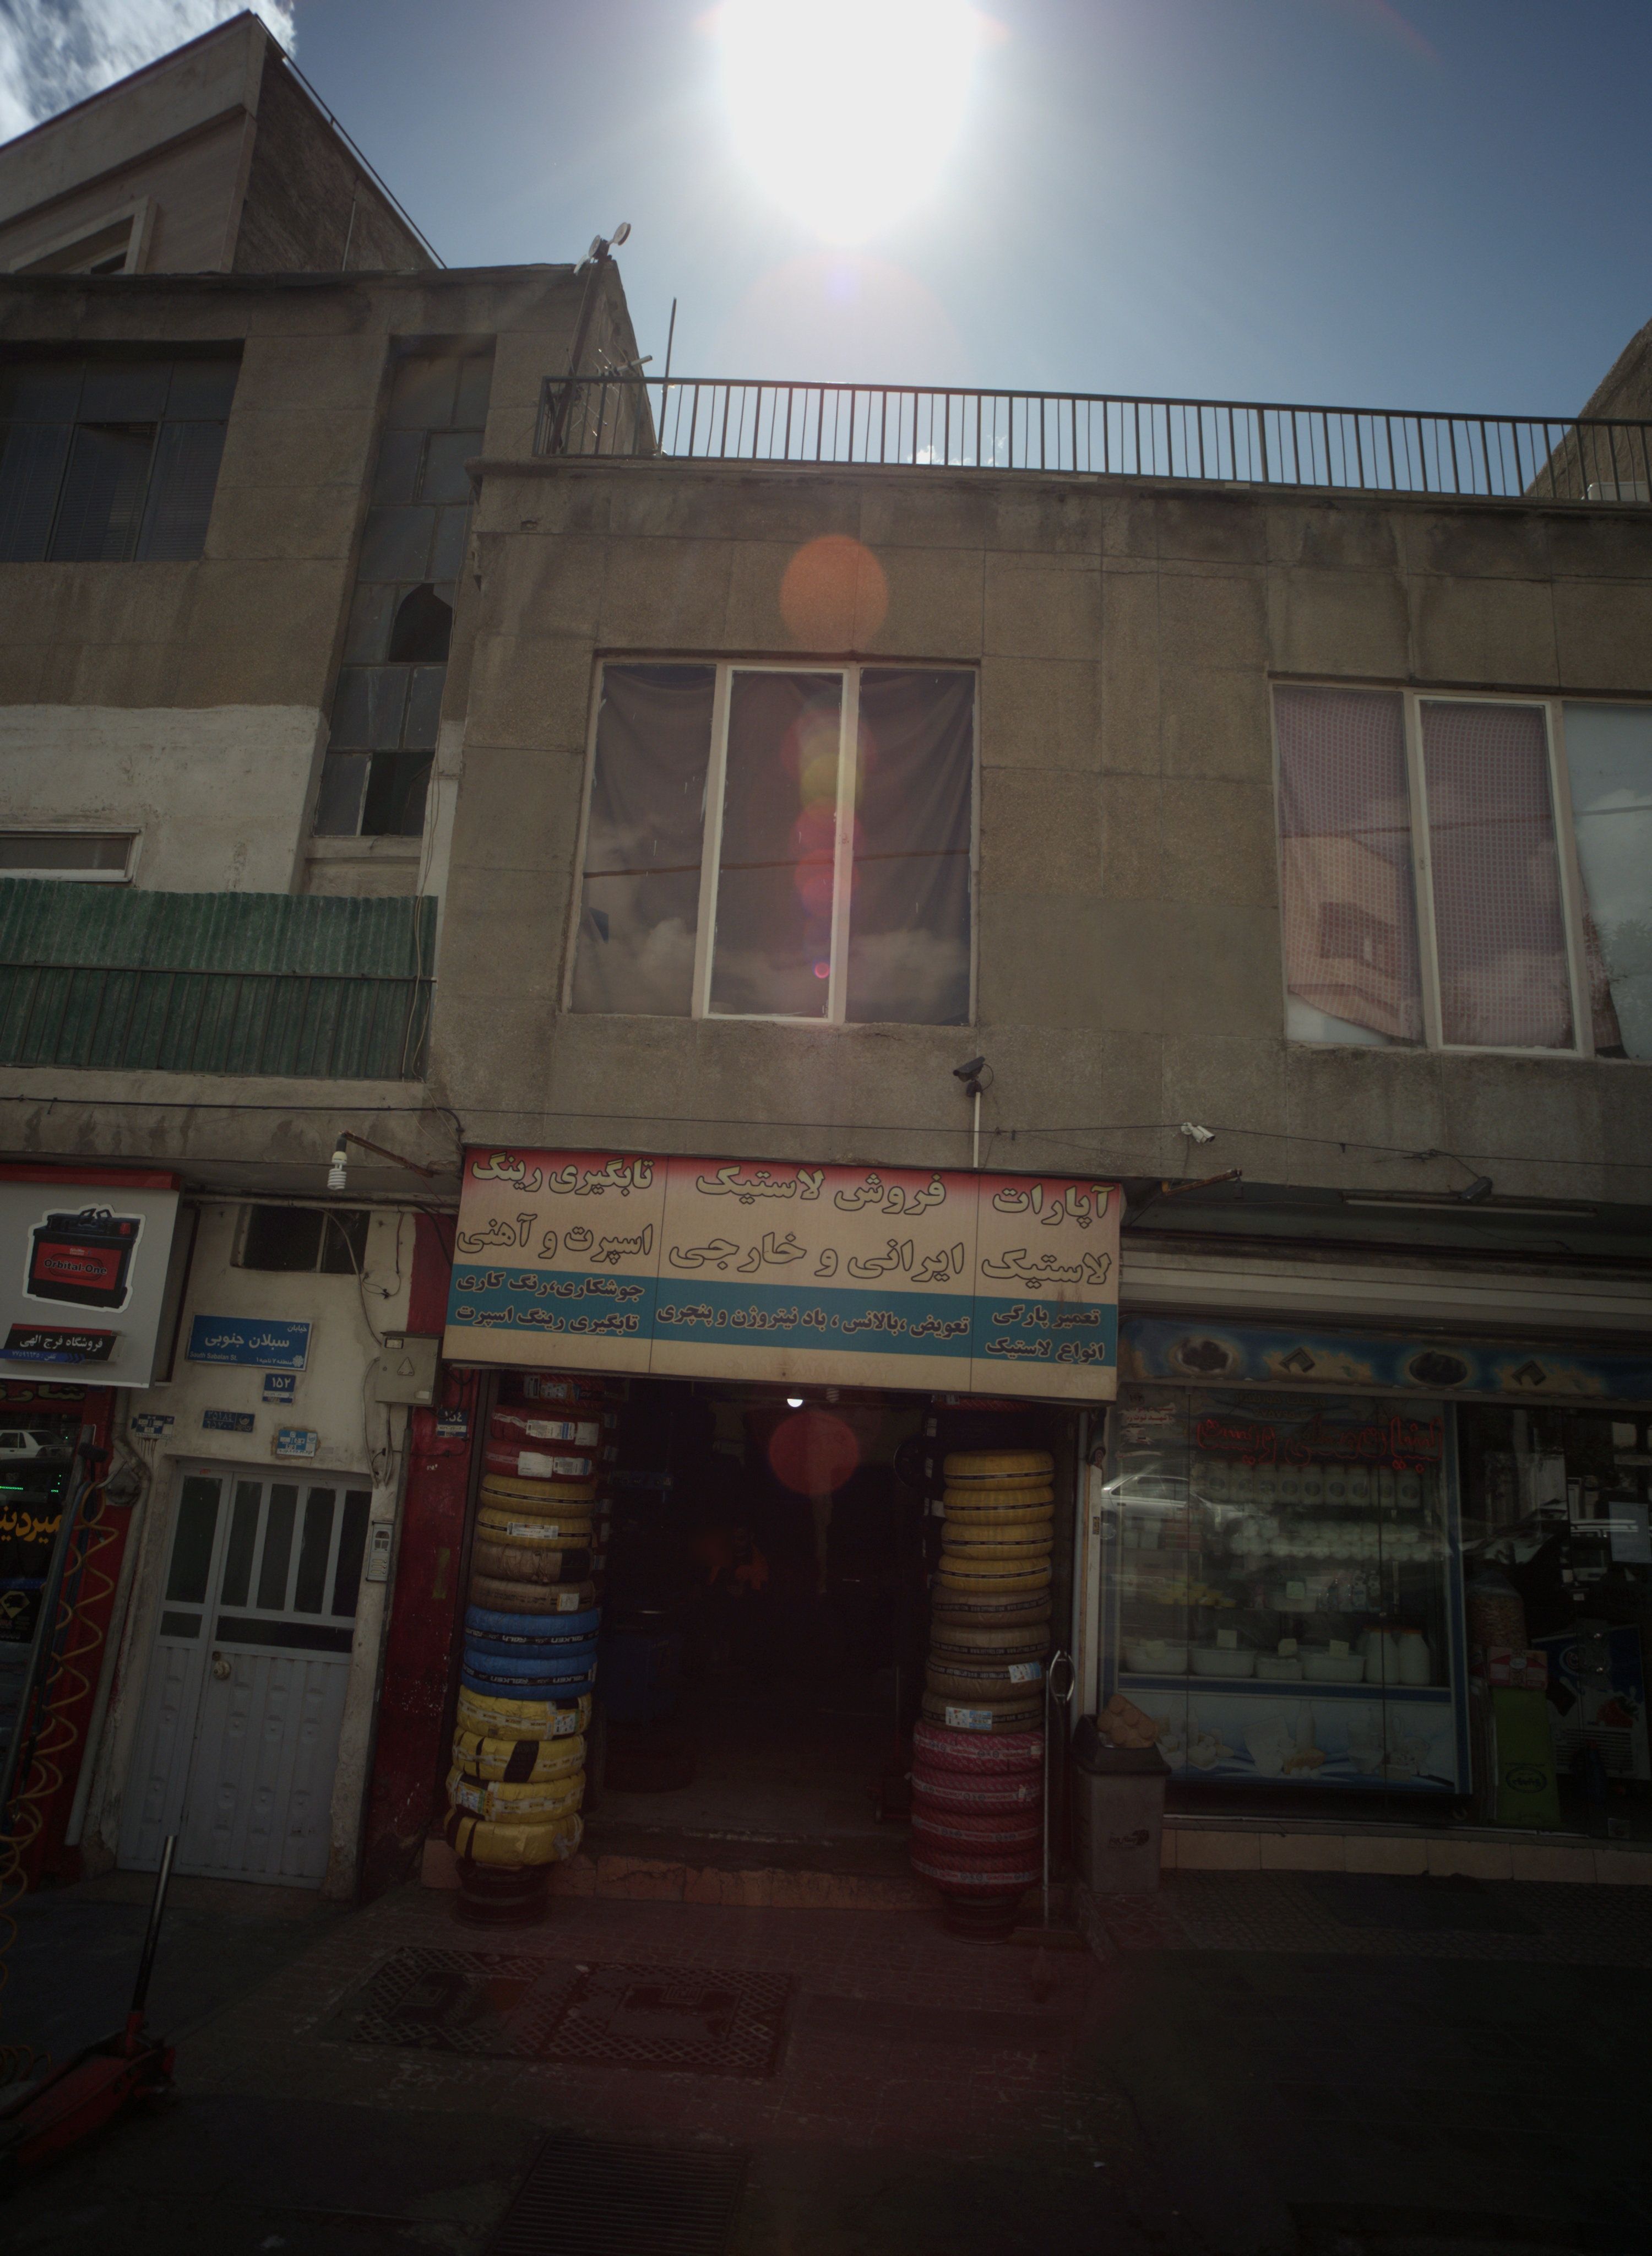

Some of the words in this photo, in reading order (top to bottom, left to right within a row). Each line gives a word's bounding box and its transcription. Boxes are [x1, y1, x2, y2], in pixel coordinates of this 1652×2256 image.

[471, 1152, 543, 1192] رینگ
[548, 1157, 654, 1196] تابگیری
[695, 1165, 825, 1205] لاستیک
[834, 1173, 947, 1215] فروش
[993, 1184, 1116, 1229] آپارات
[457, 1213, 537, 1253] آهنی
[564, 1224, 654, 1265] اسپرت
[539, 1231, 558, 1259] و
[669, 1232, 807, 1273] خارجی
[44, 1259, 107, 1275] Orbital-One
[814, 1248, 838, 1277] و
[847, 1239, 965, 1282] ایرانی
[981, 1249, 1112, 1289] لاستیک
[456, 1271, 507, 1293] کاری
[455, 1305, 514, 1327] اسپرت
[517, 1308, 565, 1332] رینگ
[569, 1313, 640, 1335] تابگیری
[656, 1304, 714, 1327] پنچری
[715, 1310, 728, 1327] و
[731, 1305, 798, 1331] نیتروژن
[801, 1308, 827, 1332] باد
[909, 1313, 970, 1340] تعویض
[1052, 1308, 1101, 1328] تعمیر
[20, 1334, 42, 1347] الهی
[43, 1336, 63, 1349] فرج
[66, 1336, 103, 1352] فروشگاه
[205, 1333, 245, 1349] جنوبی
[248, 1333, 290, 1351] سبلان
[985, 1338, 1052, 1359] لاستیک
[206, 1352, 229, 1360] Sabalan
[1056, 1342, 1105, 1364] انواع
[272, 1376, 291, 1389] ۱۵۲
